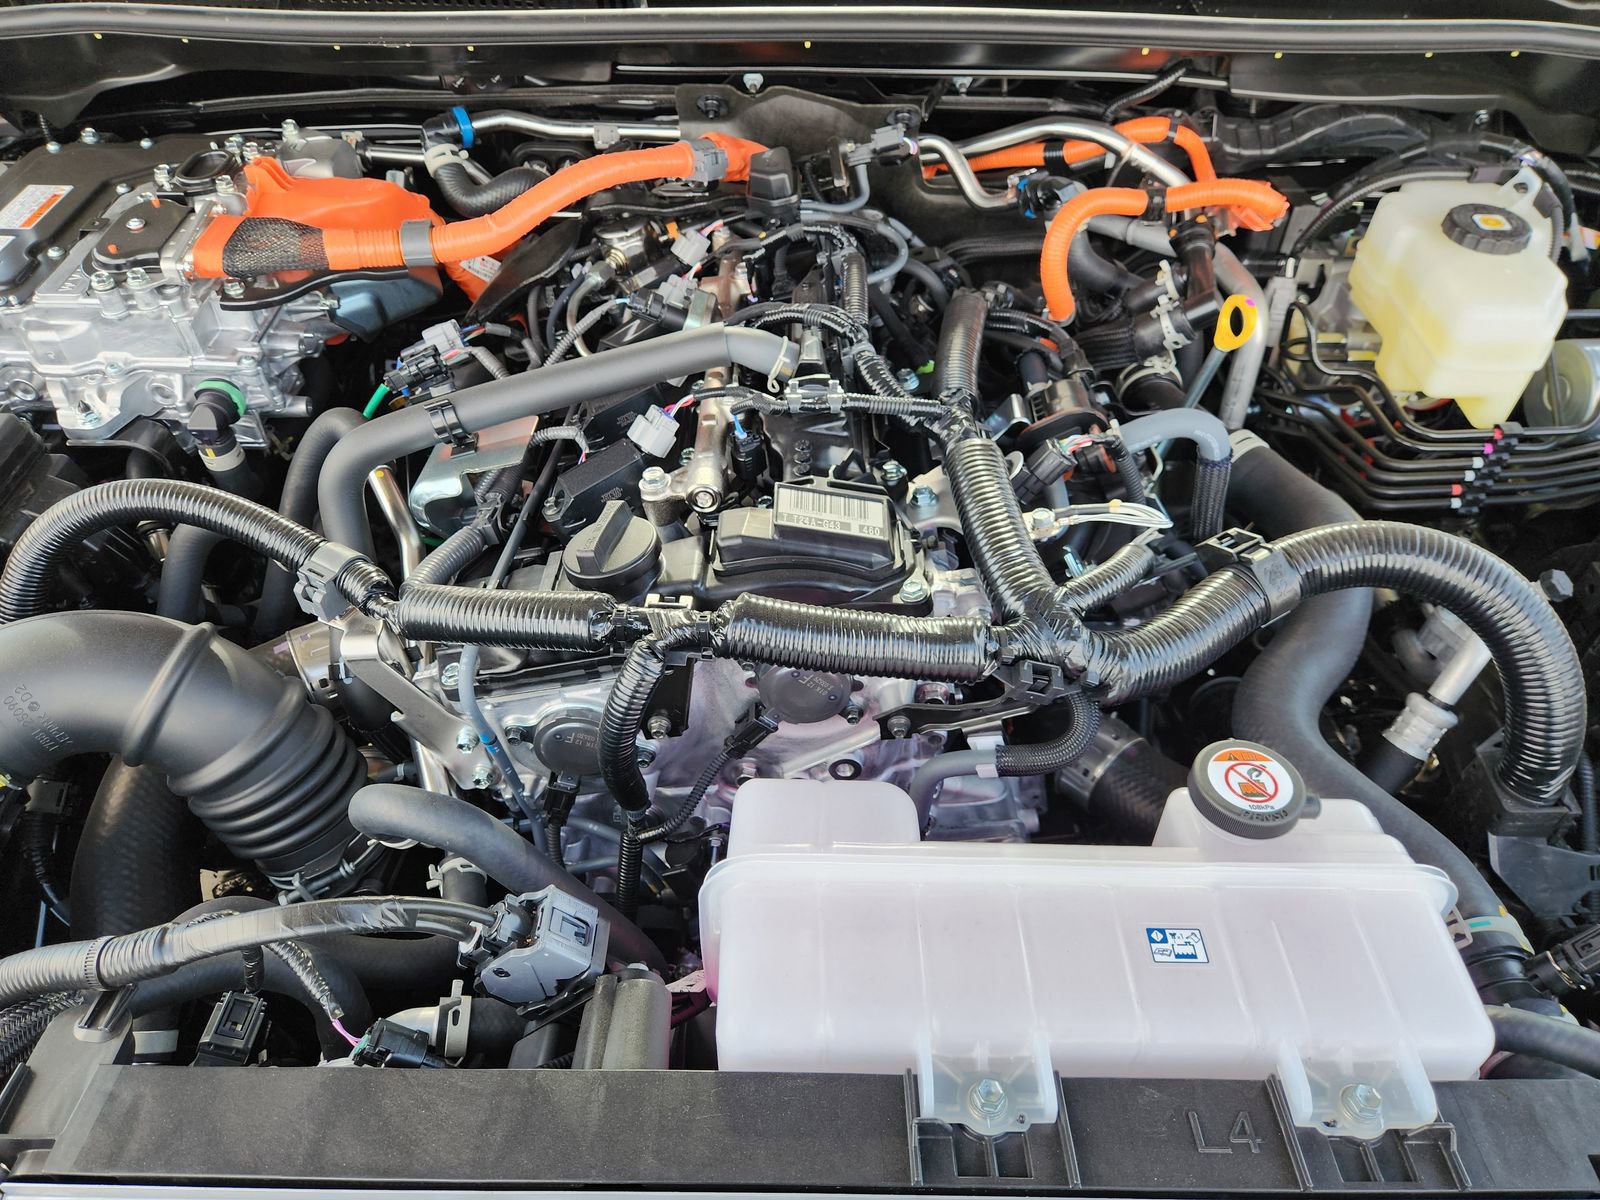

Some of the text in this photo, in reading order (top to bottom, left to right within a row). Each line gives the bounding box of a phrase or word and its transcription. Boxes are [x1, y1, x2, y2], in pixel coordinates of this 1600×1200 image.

[794, 515, 841, 530] T24A-G43
[798, 674, 814, 684] F
[14, 684, 33, 703] D2
[564, 732, 575, 744] F
[1187, 1111, 1263, 1154] L4
